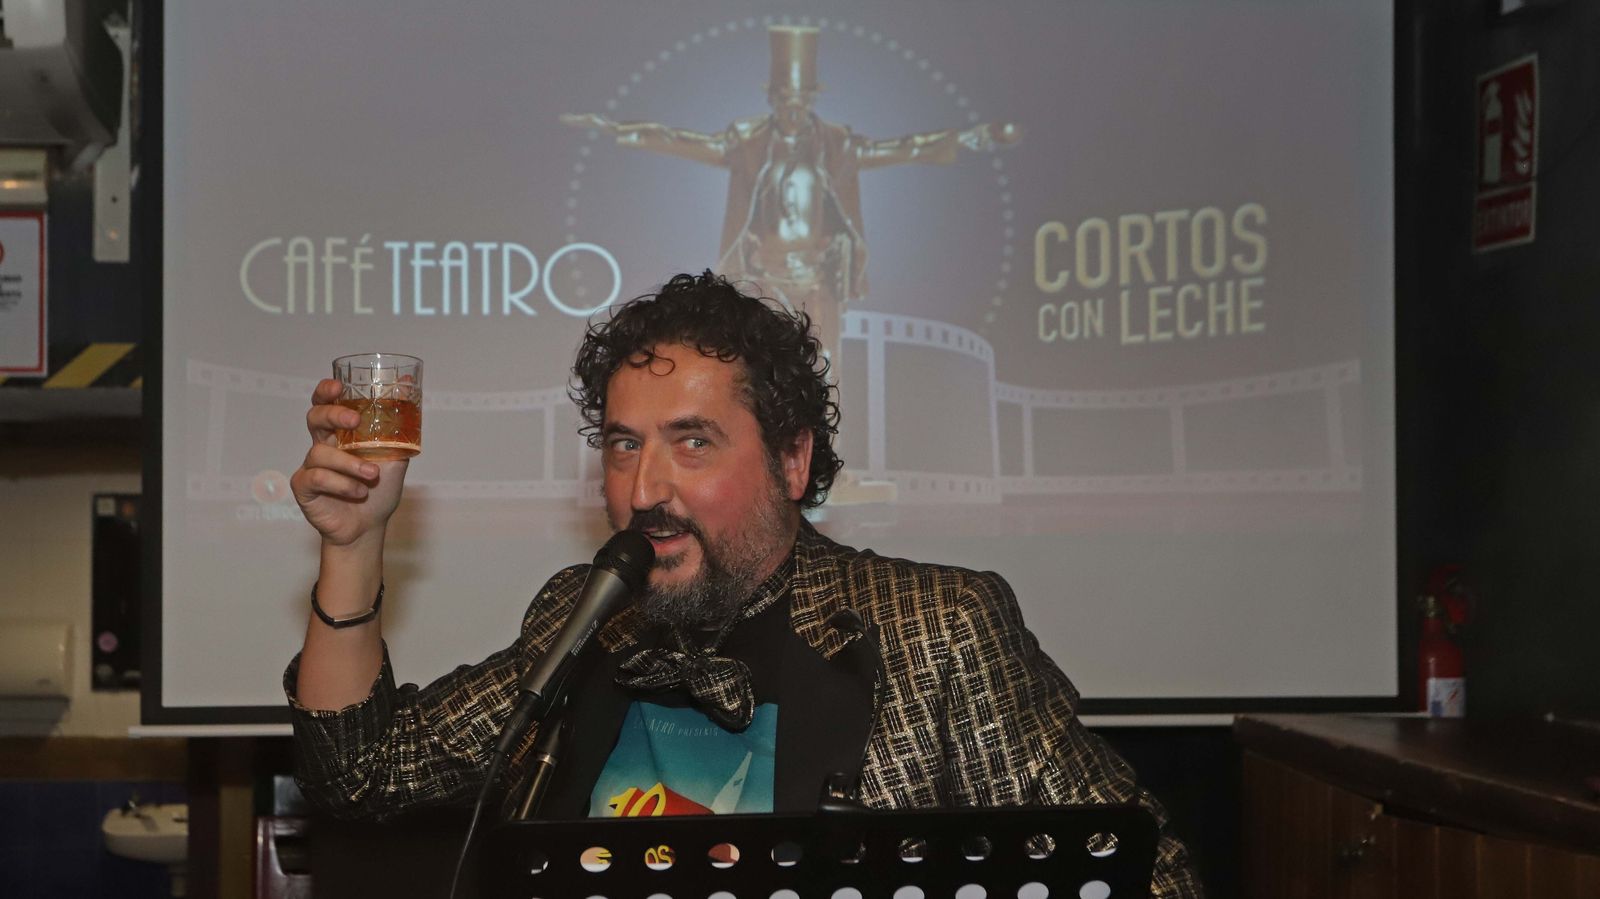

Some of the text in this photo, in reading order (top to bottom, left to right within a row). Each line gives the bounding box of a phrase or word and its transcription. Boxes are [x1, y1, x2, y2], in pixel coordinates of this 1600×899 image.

[239, 233, 622, 317] CAFÉ TEATRO
[1034, 203, 1267, 293] CORTOS
[1038, 277, 1265, 345] CON LECHE
